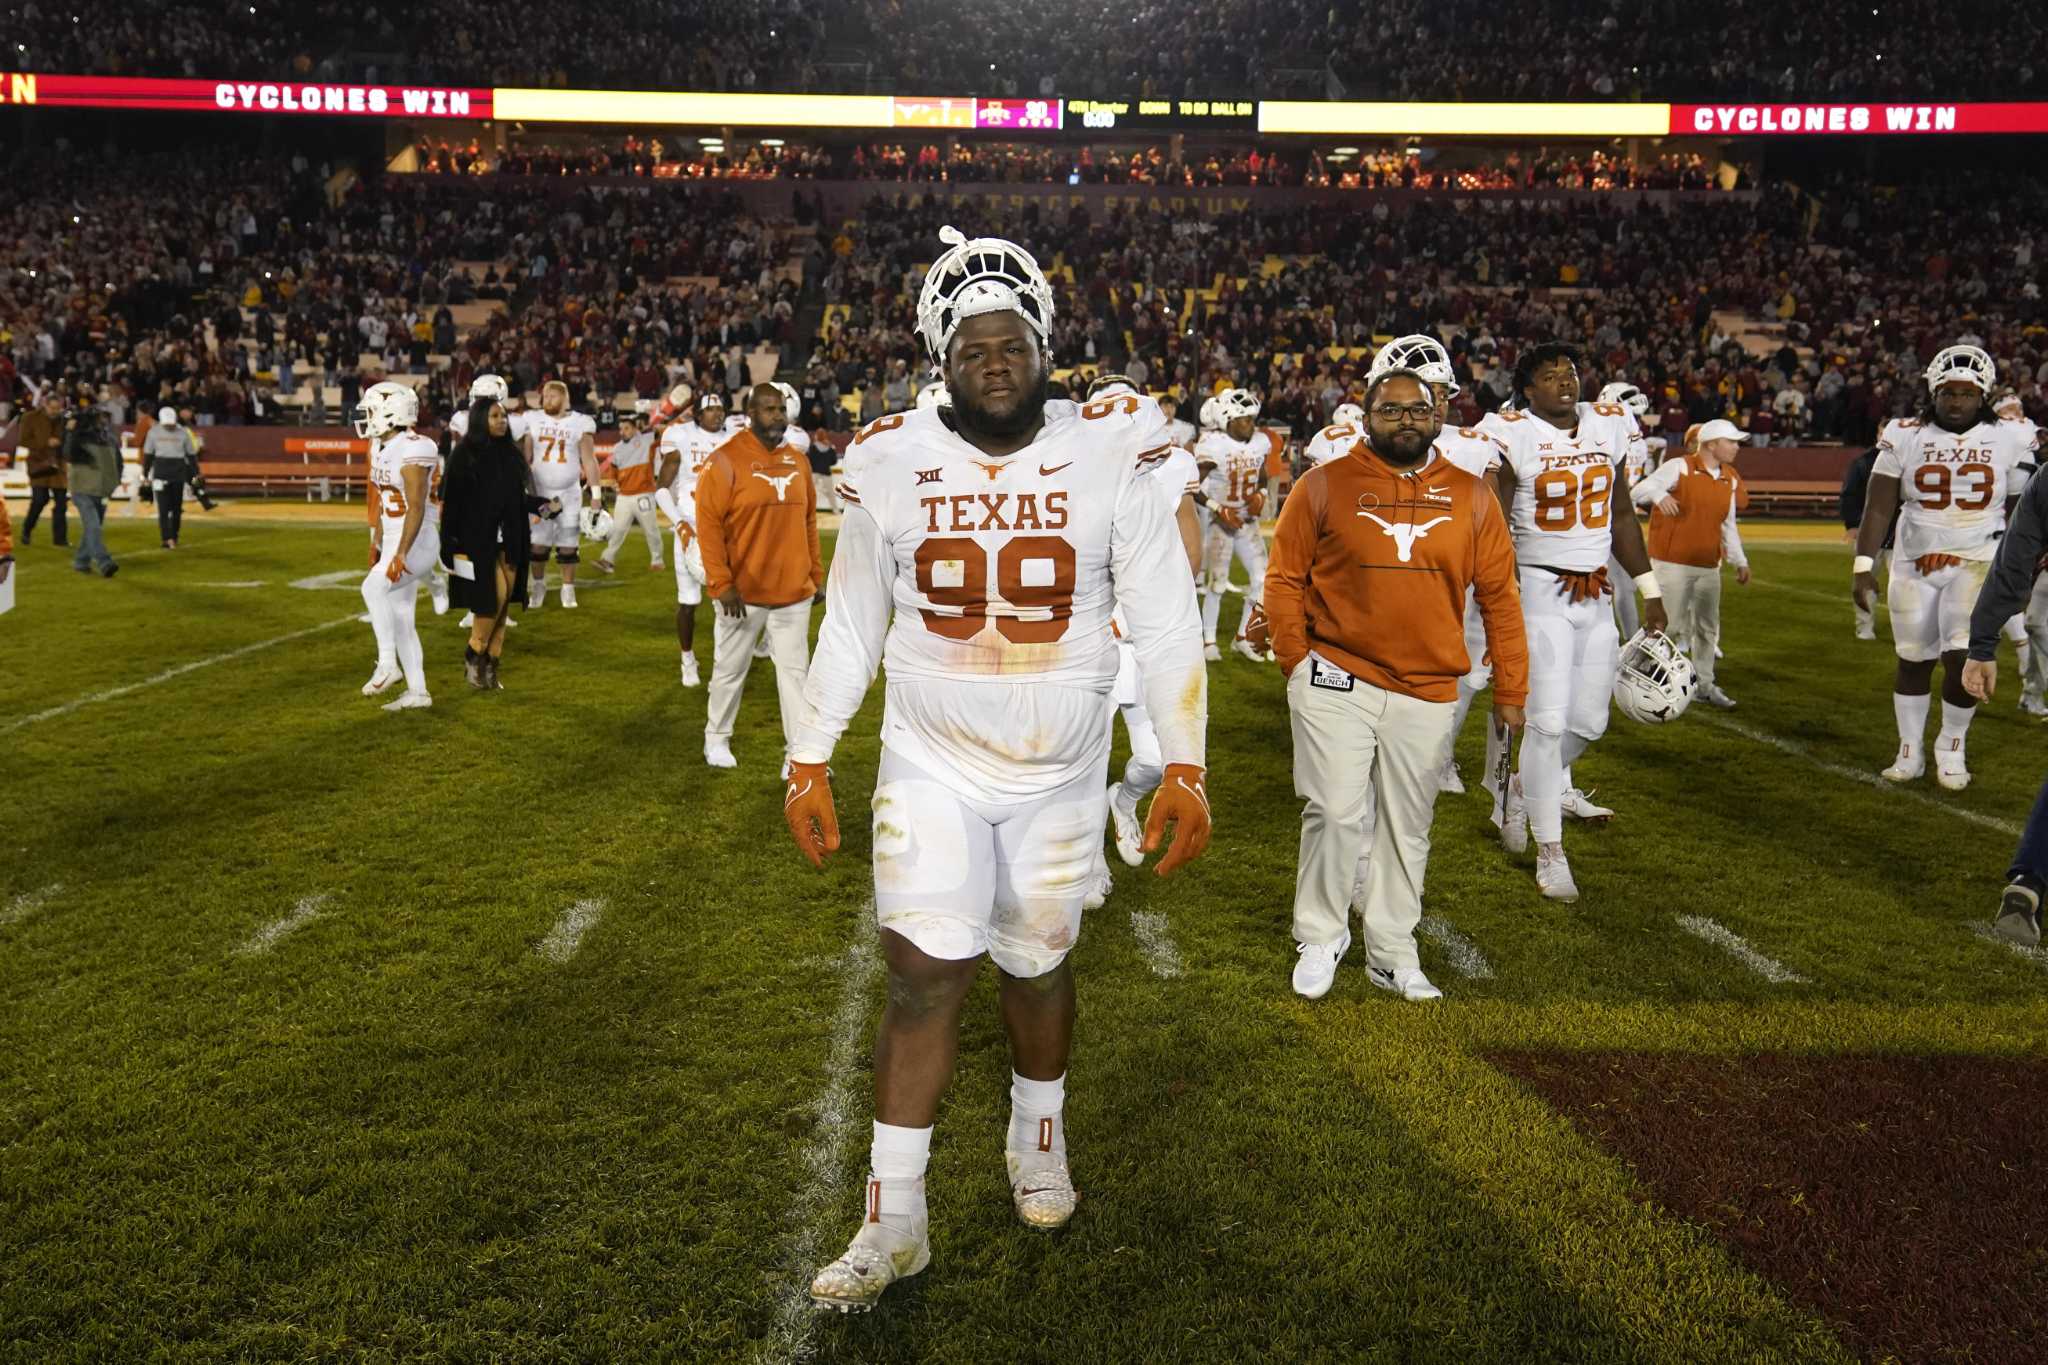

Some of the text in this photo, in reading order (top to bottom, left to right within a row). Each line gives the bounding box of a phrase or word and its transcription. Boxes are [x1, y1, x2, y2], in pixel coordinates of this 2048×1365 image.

[0, 73, 36, 103] N
[215, 83, 470, 114] CYCLONES WIN
[1694, 106, 1956, 131] CYCLONES WIN
[538, 436, 567, 464] 71
[1923, 448, 1993, 464] TEXAS
[914, 467, 943, 486] XII
[1914, 462, 1995, 511] 93
[921, 491, 1069, 533] TEXAS
[1534, 463, 1614, 532] 88
[914, 535, 1077, 644] 99
[1316, 677, 1348, 688] BENCH
